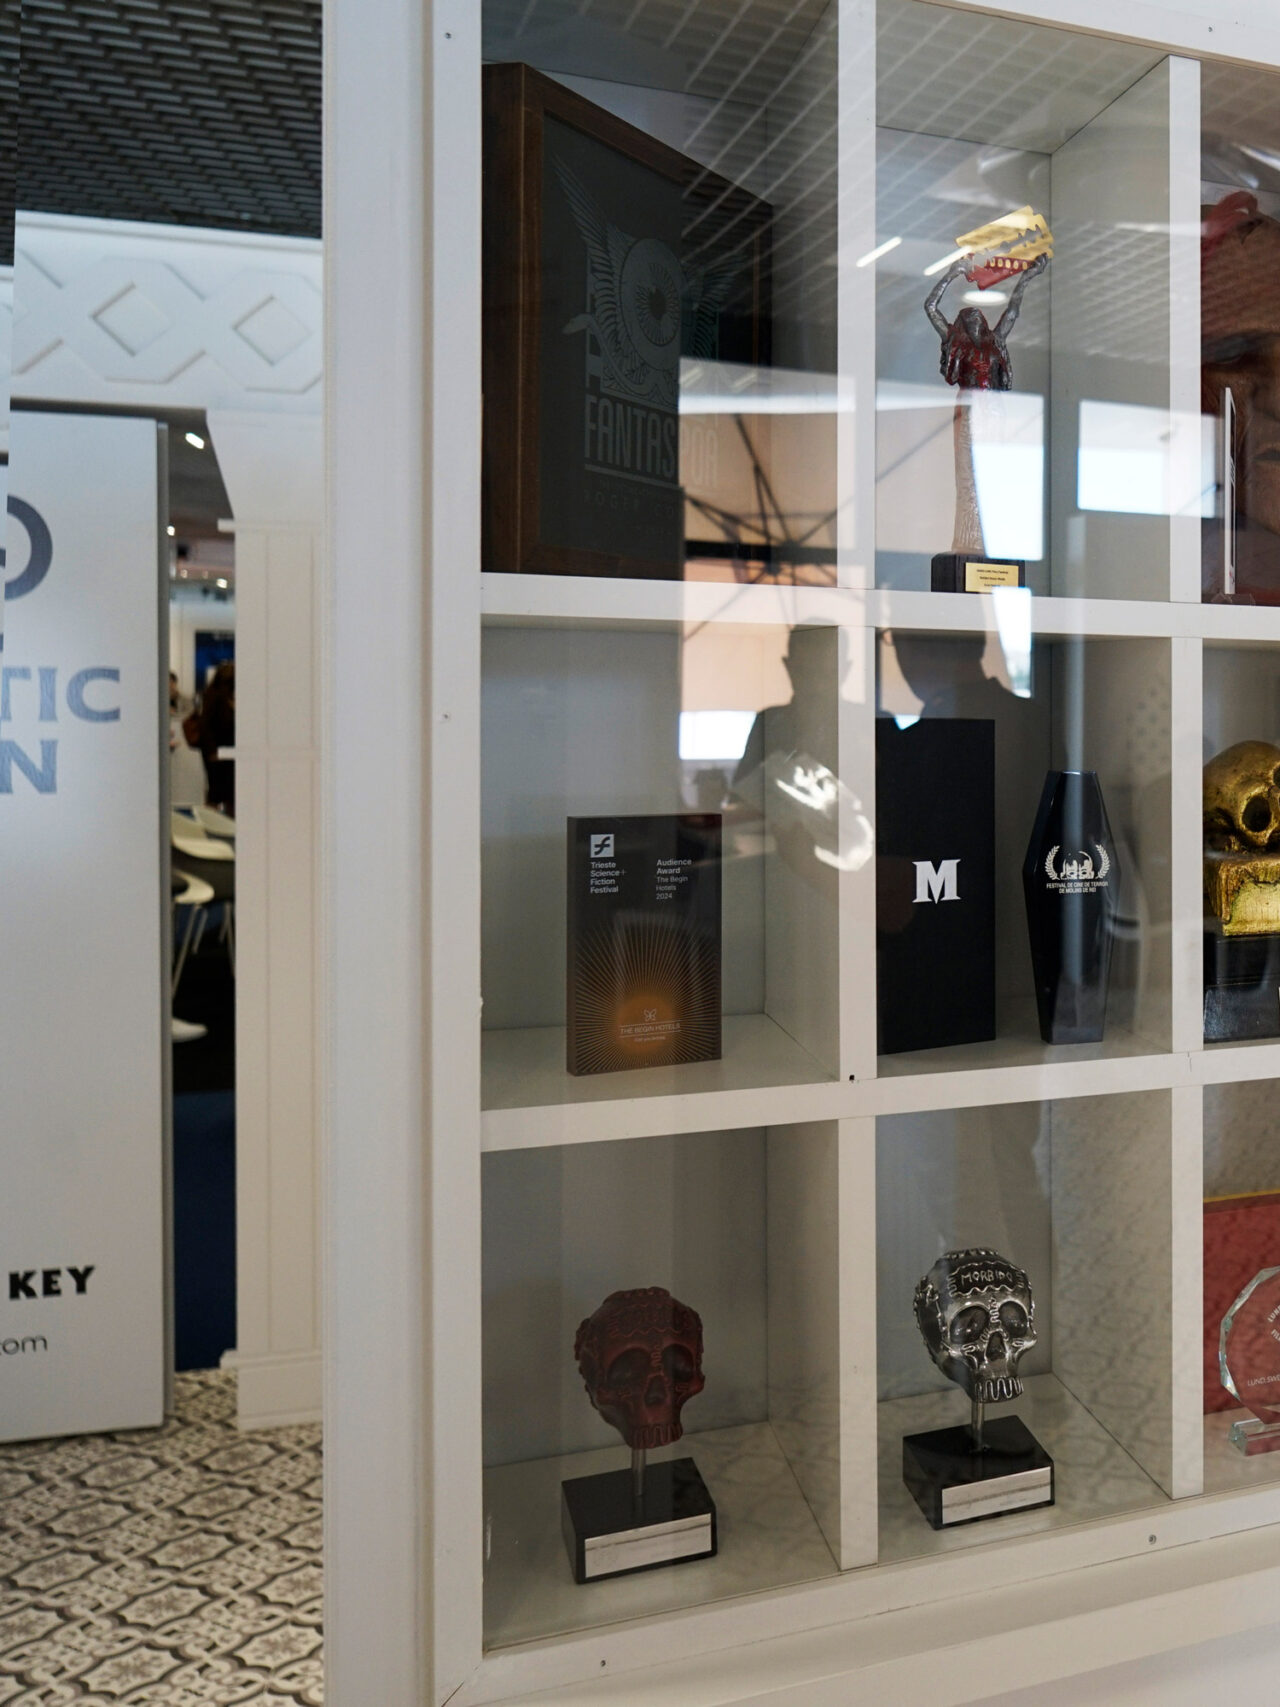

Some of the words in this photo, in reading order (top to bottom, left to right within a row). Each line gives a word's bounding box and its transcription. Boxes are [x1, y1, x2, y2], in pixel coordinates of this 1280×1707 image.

[591, 861, 616, 869] Trieste
[656, 867, 681, 875] Award
[590, 877, 615, 886] Fiction
[670, 875, 688, 884] Begin
[911, 858, 962, 905] M
[590, 886, 619, 894] Festival
[656, 884, 676, 892] Hotels
[961, 1270, 1014, 1285] MORBIDO
[9, 1265, 95, 1301] KEY
